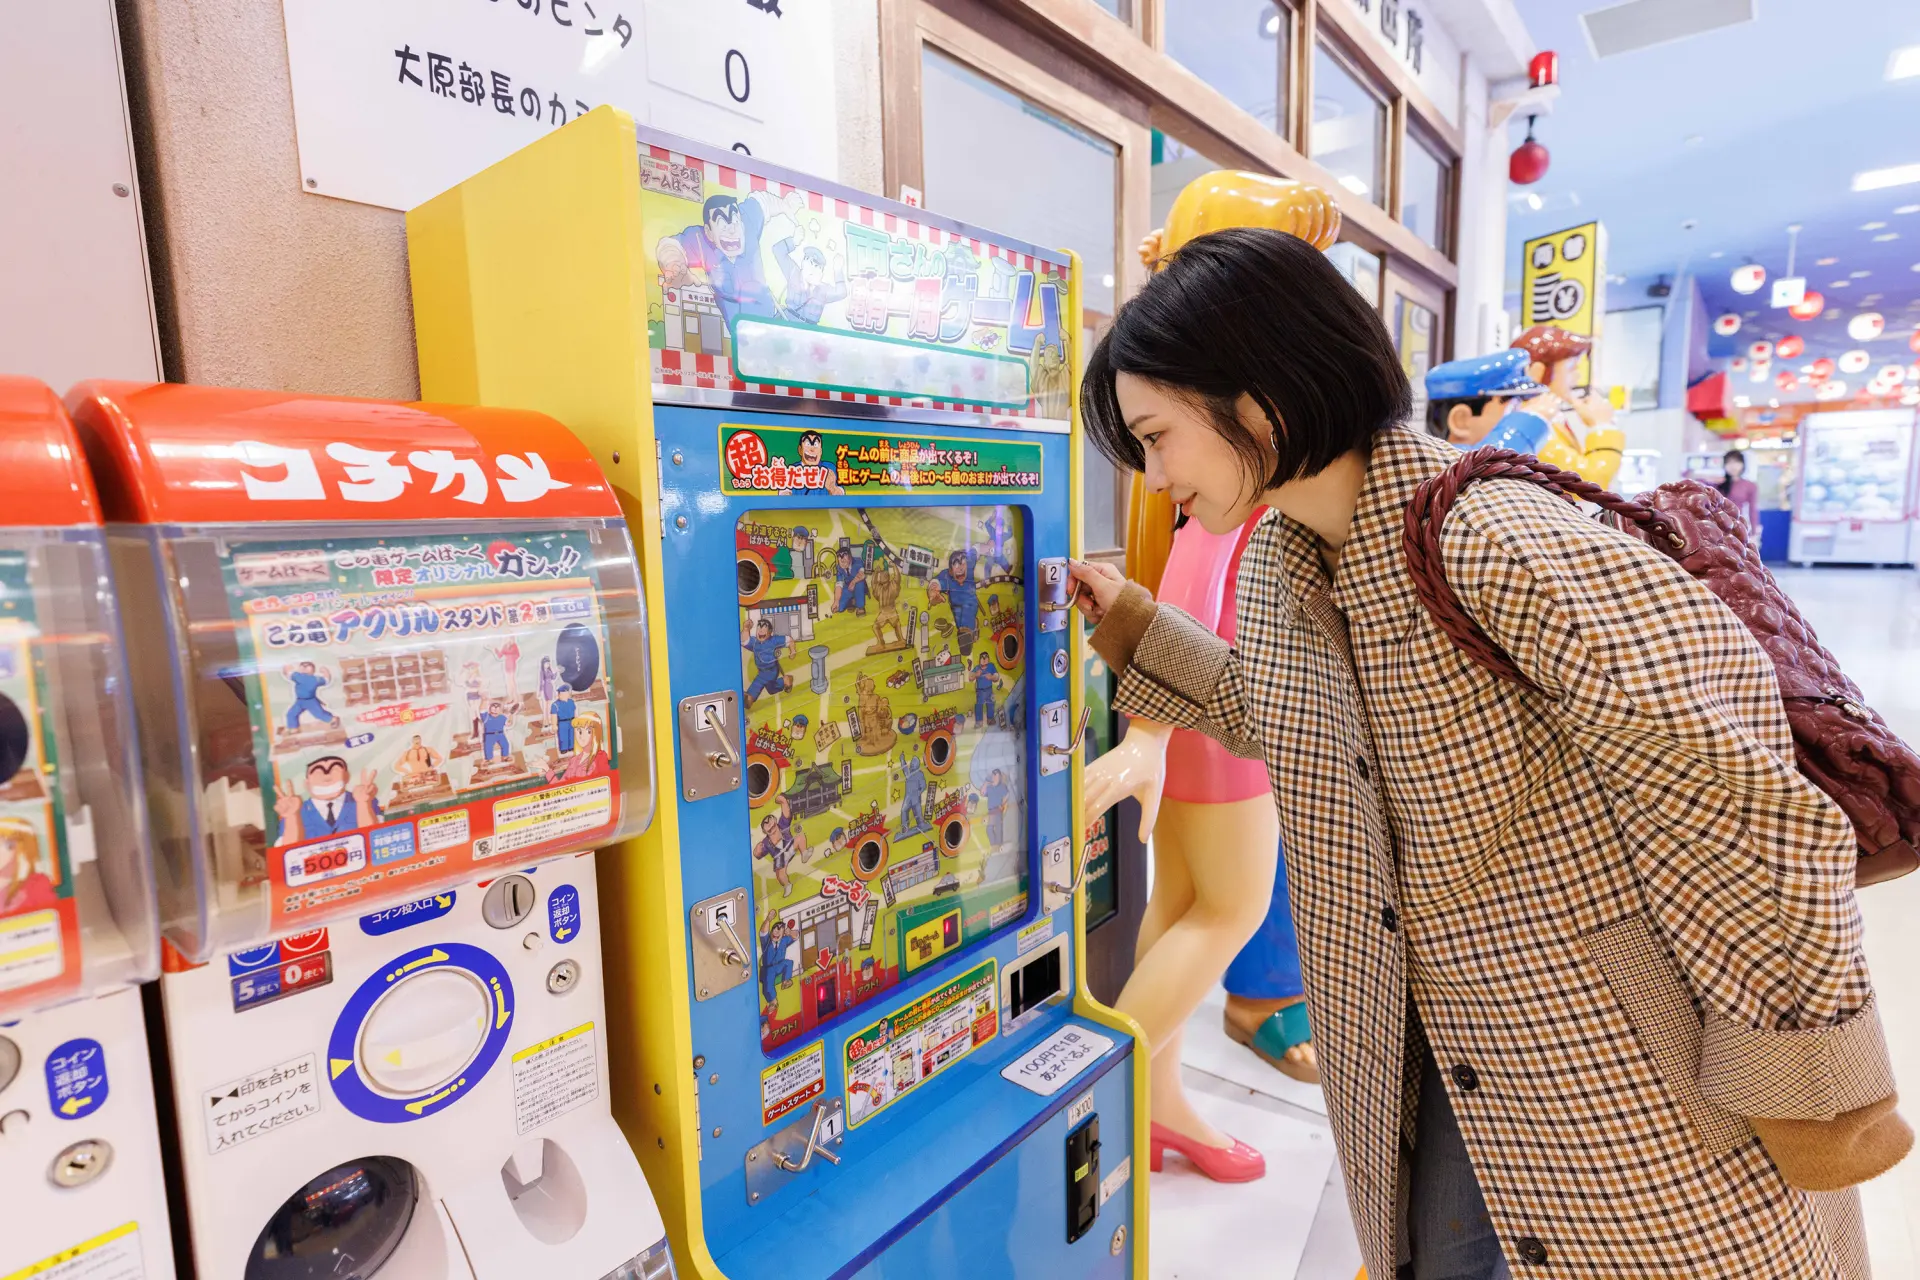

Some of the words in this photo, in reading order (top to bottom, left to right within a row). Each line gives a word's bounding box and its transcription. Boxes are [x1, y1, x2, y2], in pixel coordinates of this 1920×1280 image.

[725, 49, 750, 103] 0
[844, 221, 946, 281] 両さんの
[728, 434, 763, 478] 超
[233, 441, 573, 504] コチカメ
[753, 466, 829, 489] お得だぜ!
[1050, 566, 1057, 581] 2
[1052, 710, 1059, 723] 4
[1053, 848, 1060, 863] 6
[372, 897, 433, 924] コイン投入口
[551, 893, 575, 906] コイン
[552, 907, 571, 919] 返却
[553, 913, 578, 927] ボタン
[51, 1047, 97, 1071] コイン
[1020, 1032, 1081, 1076] 100円で1回
[1040, 1044, 1093, 1082] あそべるよ
[213, 1082, 312, 1127] てからコインを
[767, 1089, 811, 1119] ゲームスタート
[216, 1104, 315, 1150] 入れてください。
[827, 1119, 834, 1136] 1
